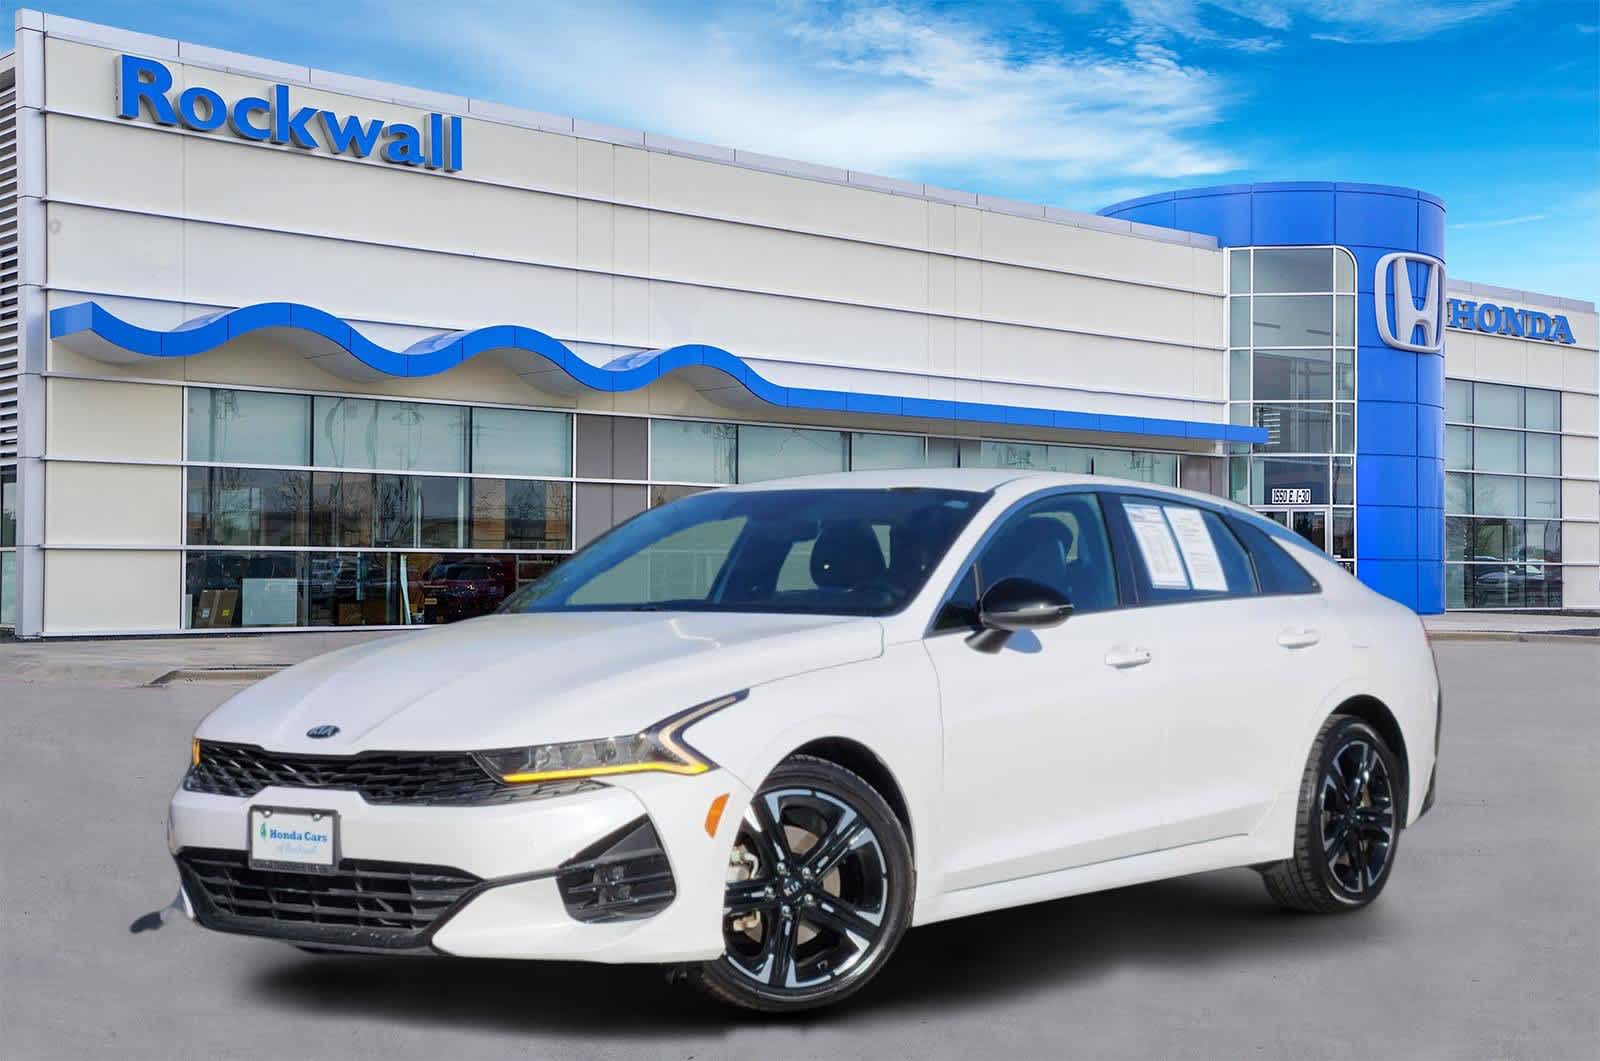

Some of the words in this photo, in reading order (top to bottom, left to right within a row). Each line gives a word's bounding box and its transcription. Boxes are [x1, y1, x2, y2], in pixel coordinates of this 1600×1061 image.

[117, 54, 463, 172] Rockwall
[1447, 298, 1577, 345] HONDA
[1273, 489, 1288, 503] 1550
[1296, 490, 1310, 503] I-30
[270, 828, 302, 841] Honda
[304, 831, 328, 843] Cars
[784, 880, 801, 896] KIA
